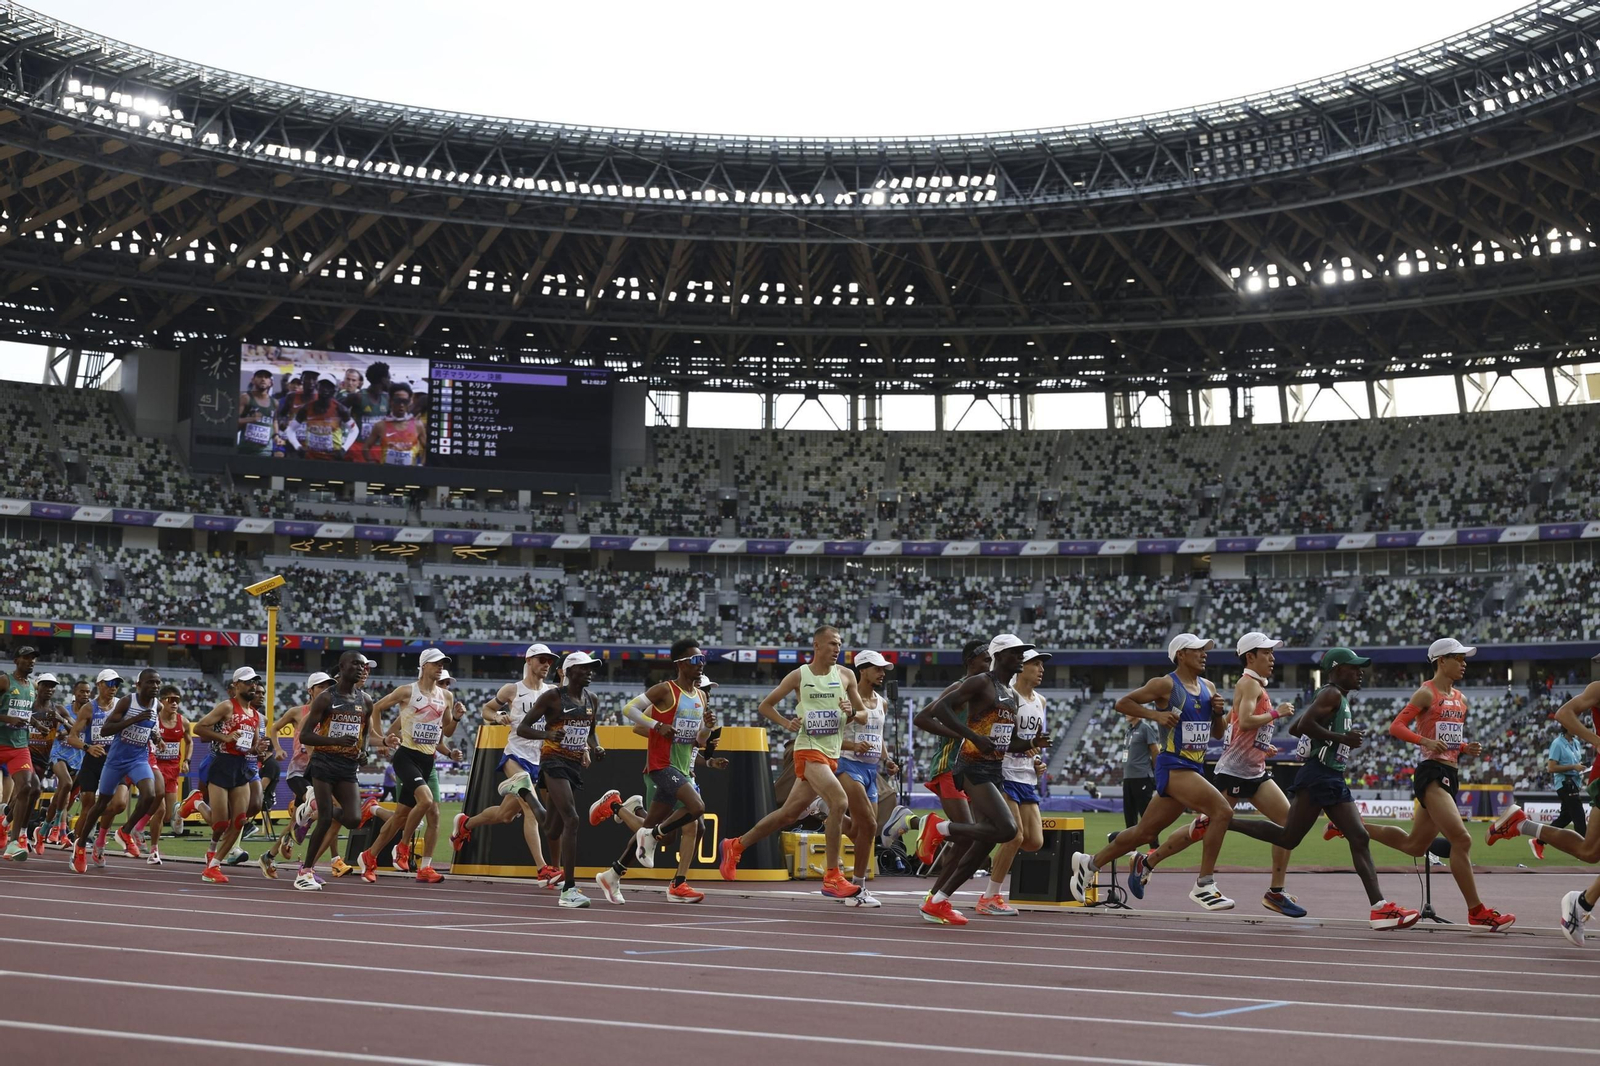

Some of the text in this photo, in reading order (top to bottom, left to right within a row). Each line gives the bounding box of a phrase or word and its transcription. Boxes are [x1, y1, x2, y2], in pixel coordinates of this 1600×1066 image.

[434, 369, 480, 380] 男子マラソン
[200, 394, 212, 404] 45
[816, 710, 838, 719] TDK
[134, 725, 149, 735] TDK
[340, 723, 359, 731] TDK
[422, 724, 438, 732] TDK
[1447, 723, 1462, 732] TDK
[122, 730, 147, 744] PAULUS
[413, 731, 437, 739] NAERT
[1438, 733, 1461, 743] KONDO
